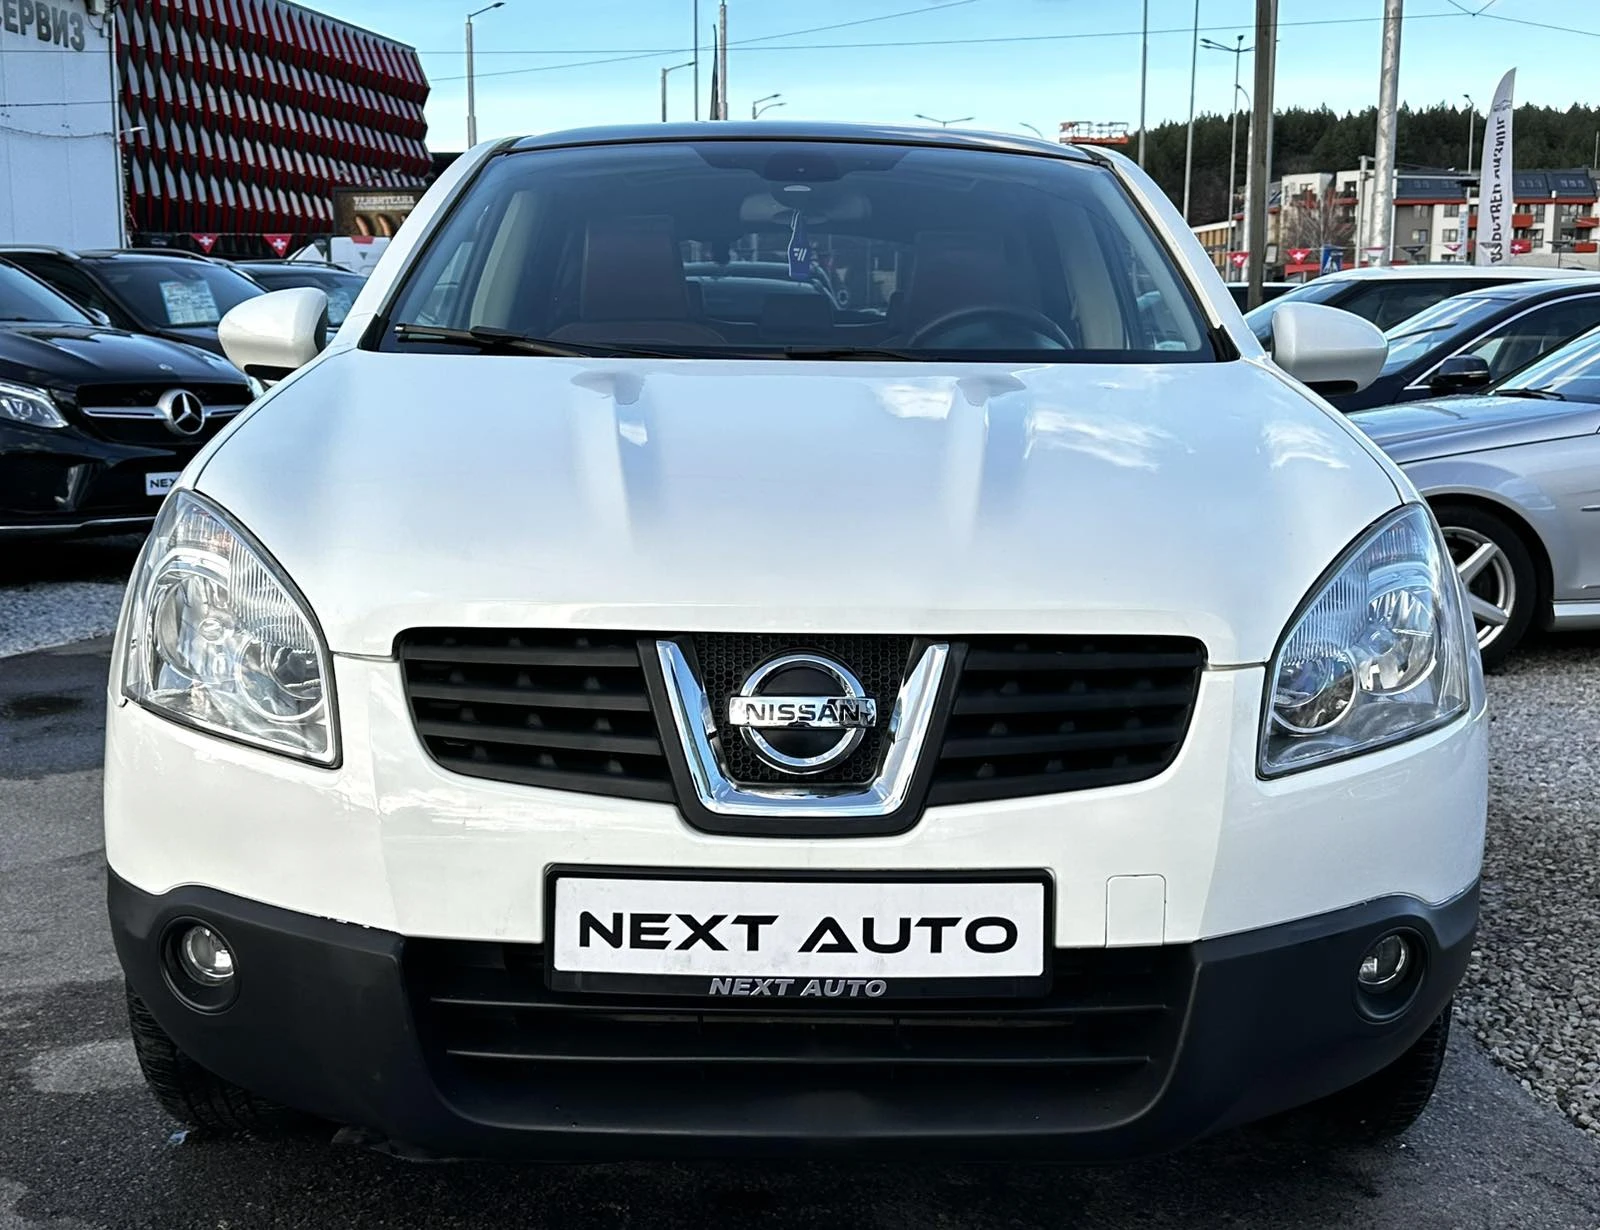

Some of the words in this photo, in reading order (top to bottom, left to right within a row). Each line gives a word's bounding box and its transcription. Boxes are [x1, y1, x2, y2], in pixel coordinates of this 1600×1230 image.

[0, 0, 85, 52] ЕРВИЗ
[745, 703, 860, 722] NISSAN
[579, 911, 779, 951] NEXT
[797, 916, 1018, 954] AUTO
[708, 977, 795, 996] NEXT
[800, 979, 887, 997] AUTO
